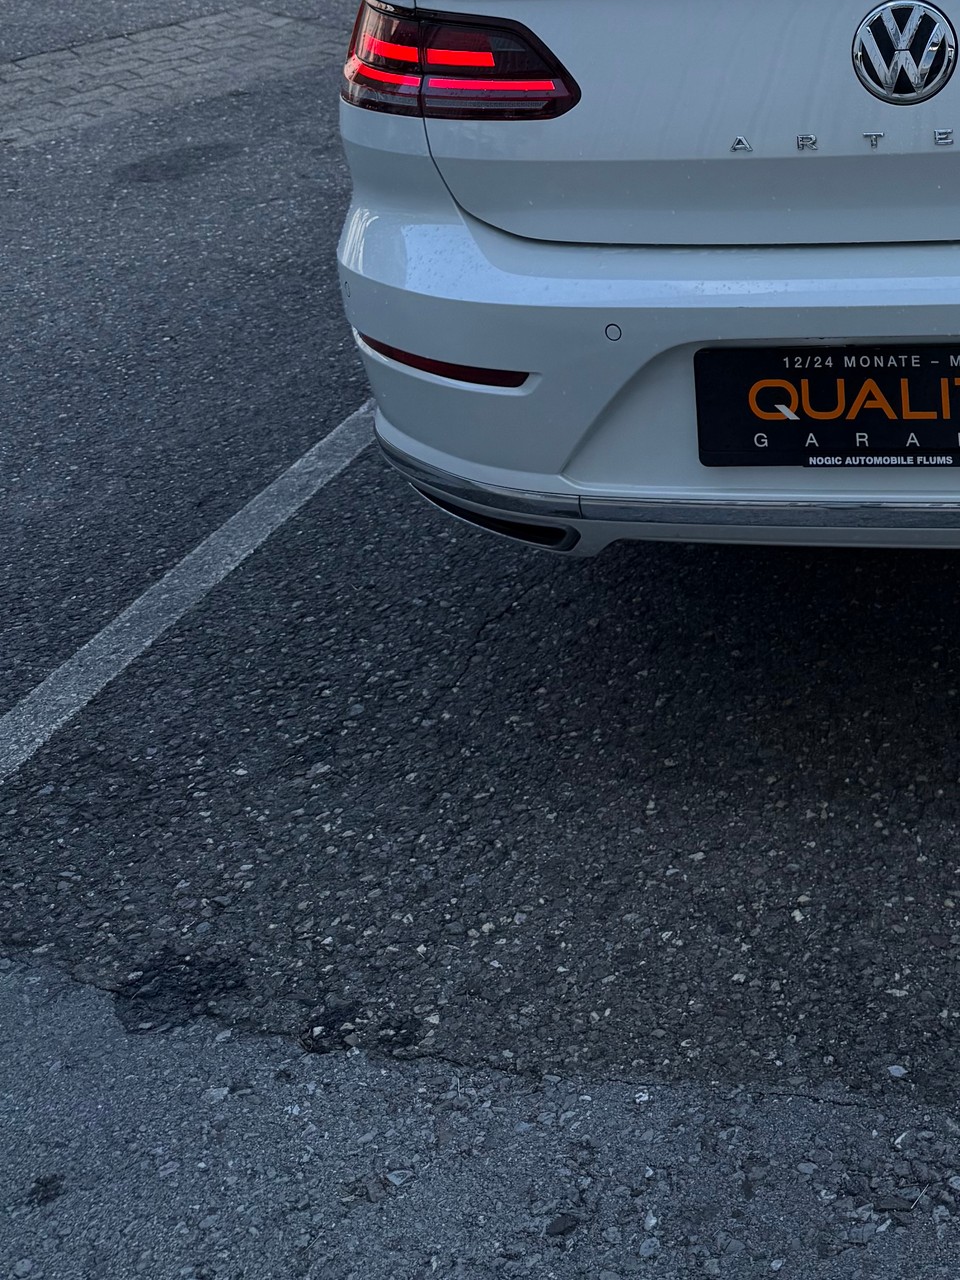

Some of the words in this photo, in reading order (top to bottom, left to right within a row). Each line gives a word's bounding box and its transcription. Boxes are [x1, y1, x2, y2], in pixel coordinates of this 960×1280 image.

[783, 356, 833, 368] 12/24
[844, 355, 921, 368] MONATE
[809, 456, 842, 465] NOGIC
[845, 456, 914, 465] AUTOMOBILE
[917, 456, 953, 465] FLUMS
